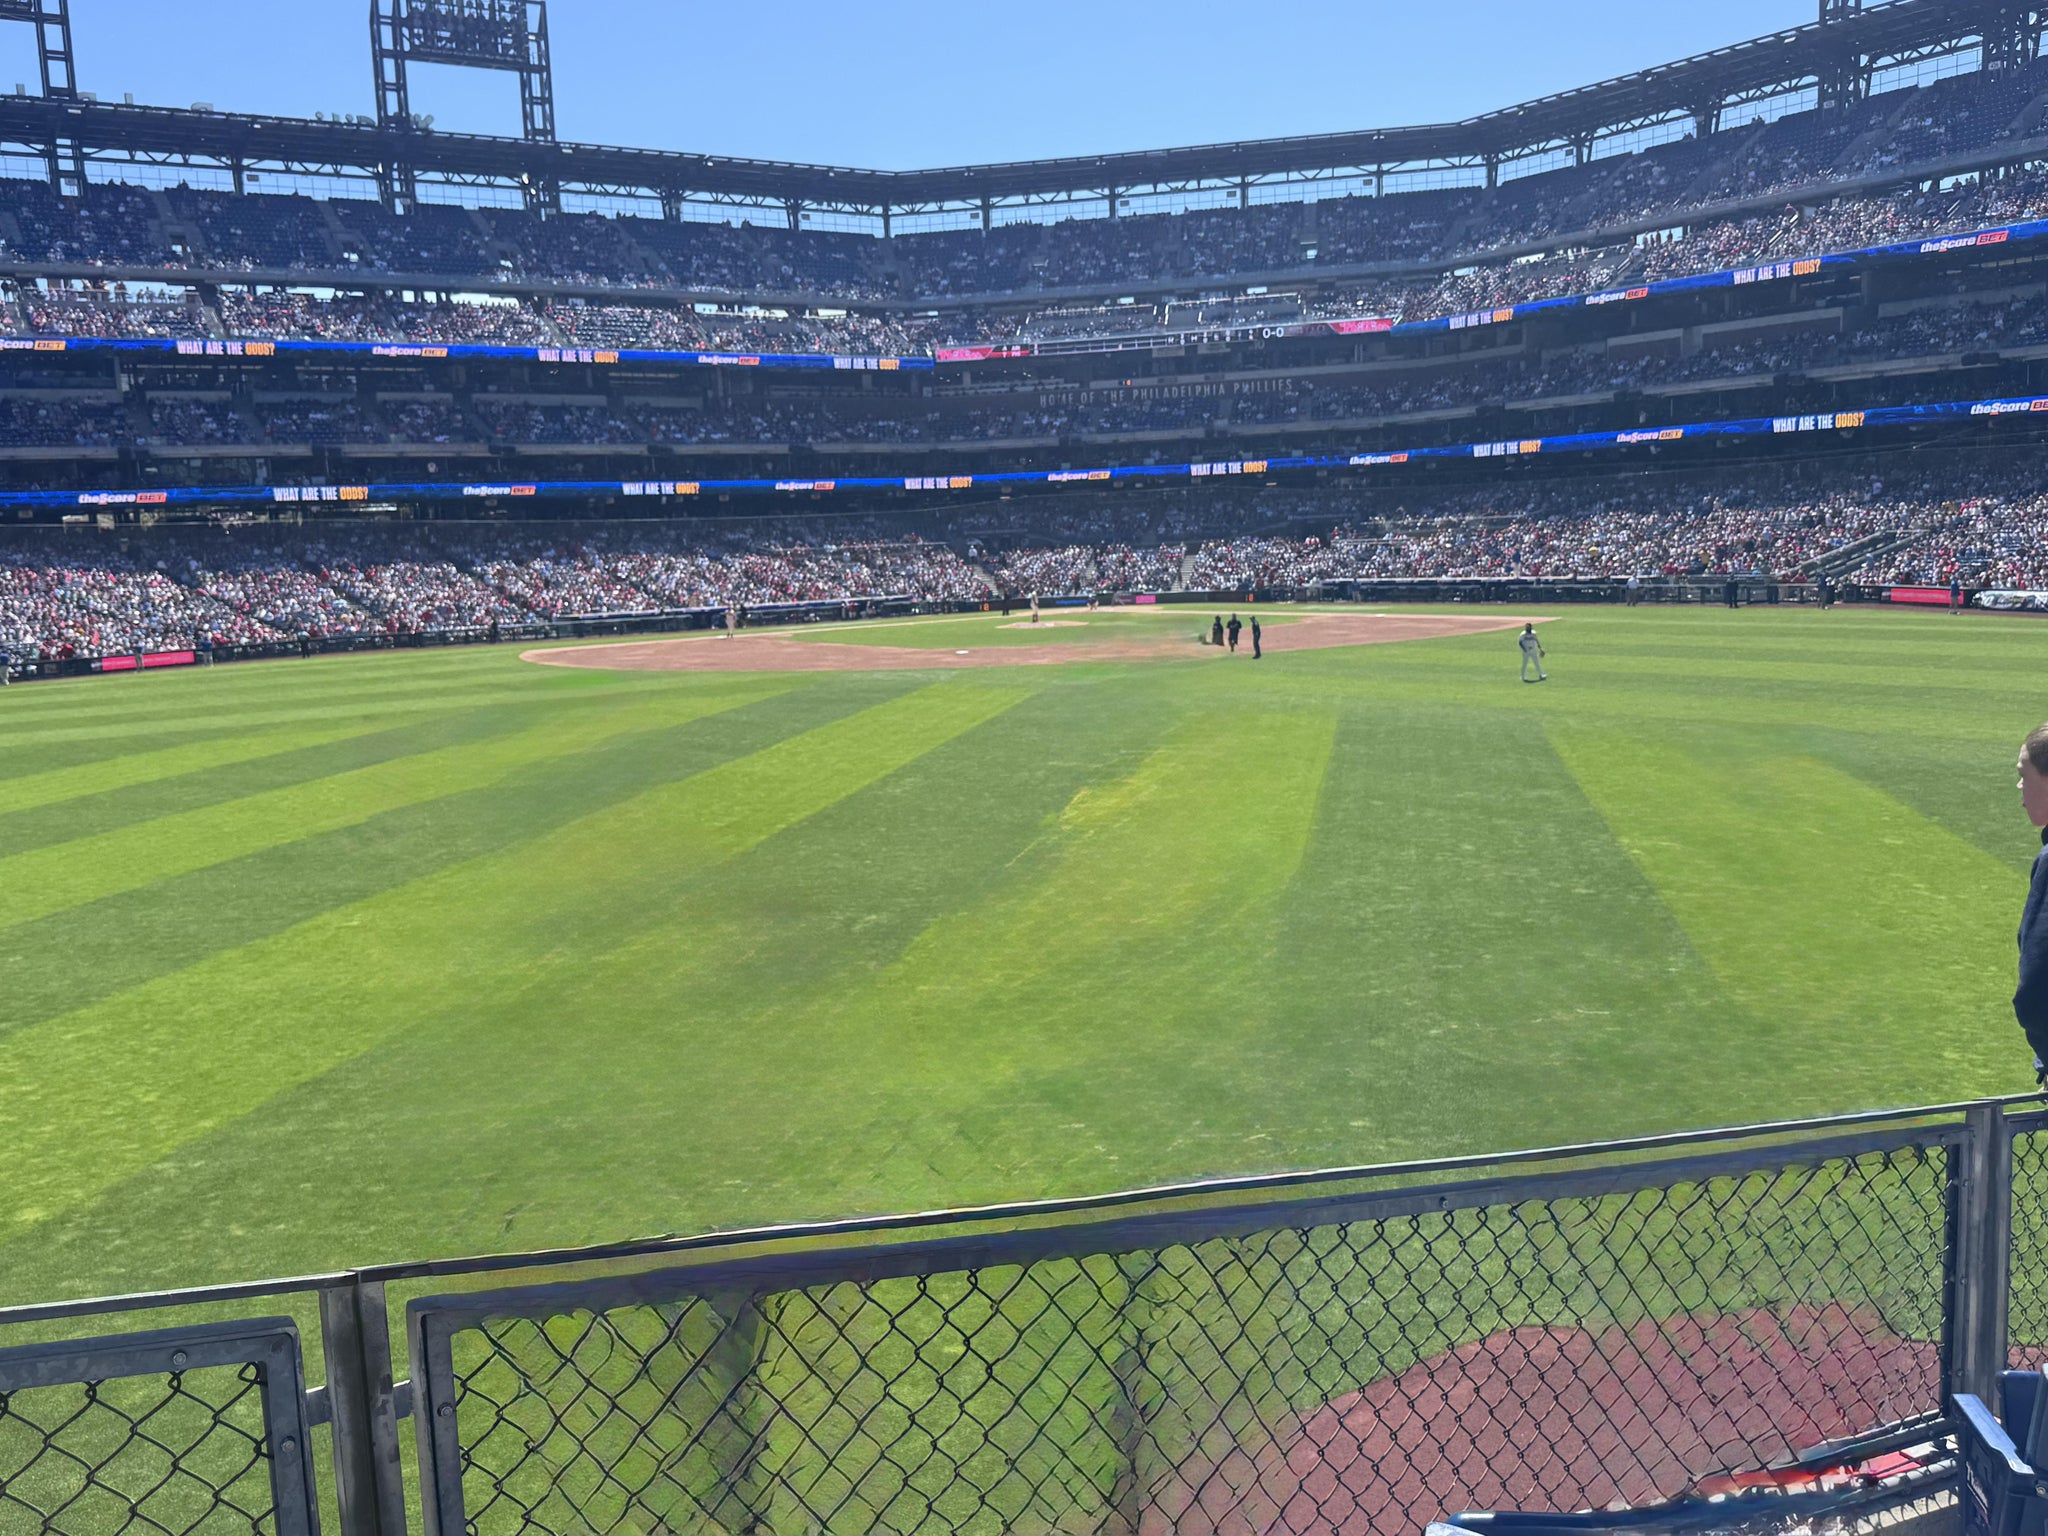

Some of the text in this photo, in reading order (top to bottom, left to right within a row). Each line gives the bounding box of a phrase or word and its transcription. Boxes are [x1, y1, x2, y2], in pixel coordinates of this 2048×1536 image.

[1976, 231, 2009, 246] BET
[1733, 259, 1821, 285] WHAT ARE THE ODDS?
[1449, 316, 1466, 329] WHAT
[1467, 315, 1479, 327] ARE
[1480, 312, 1492, 325] THE
[1263, 327, 1284, 338] 0-0
[177, 341, 203, 354] WHAT
[206, 341, 223, 355] ARE
[226, 342, 243, 355] THE
[538, 350, 560, 361] WHAT
[562, 350, 577, 362] ARE
[579, 350, 593, 362] THE
[833, 358, 851, 369] WHAT
[853, 358, 865, 369] ARE
[867, 358, 878, 369] THE
[1080, 391, 1095, 404] OF
[1103, 390, 1125, 403] THE
[1132, 383, 1226, 401] PHILADELPHIA
[1773, 412, 1865, 433] WHAT ARE THE ODDS?
[1473, 444, 1491, 457] WHAT
[1492, 443, 1504, 456] ARE
[1506, 442, 1518, 454] THE
[1190, 464, 1211, 476] WHAT
[1212, 463, 1226, 475] ARE
[1228, 462, 1242, 474] THE
[622, 483, 644, 495] WHAT
[645, 483, 659, 495] ARE
[661, 483, 674, 495] THE
[905, 478, 922, 490] WHAT
[923, 478, 935, 489] ARE
[936, 477, 948, 489] THE
[273, 487, 368, 501] WHAT ARE THE ODDS?
